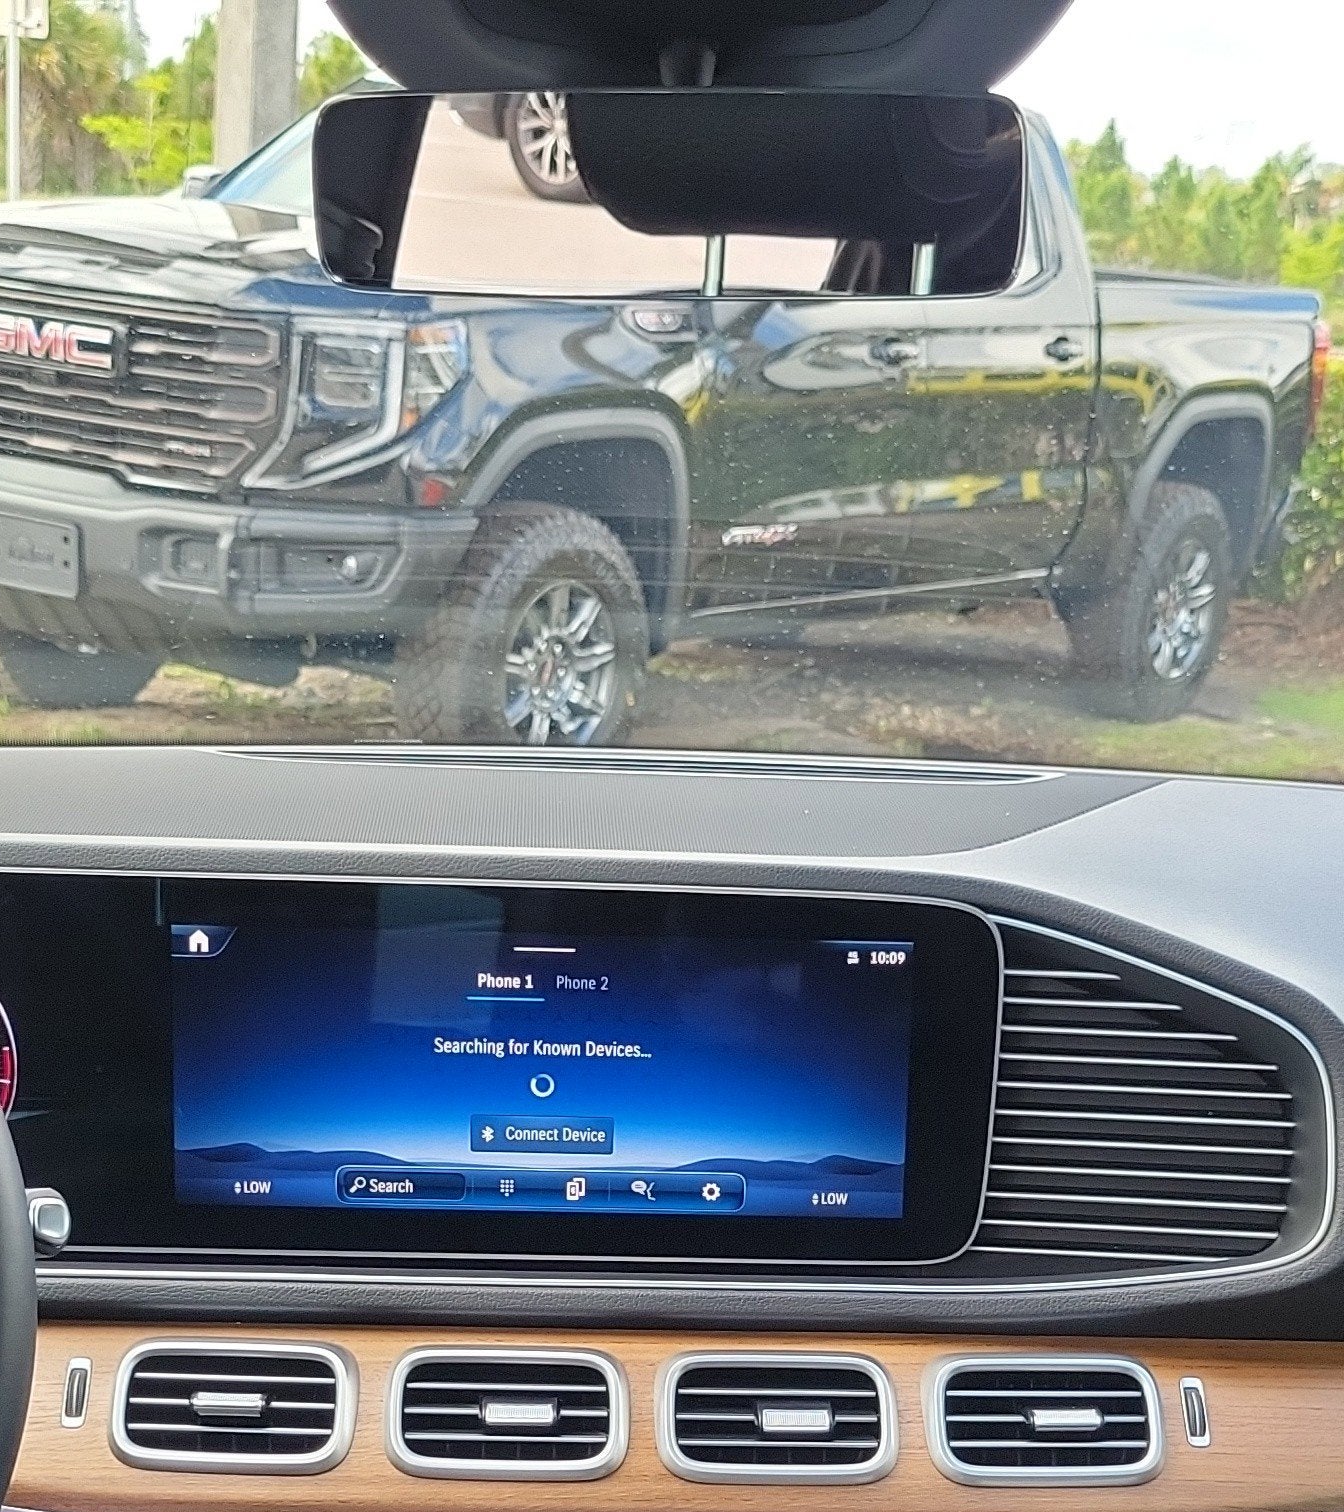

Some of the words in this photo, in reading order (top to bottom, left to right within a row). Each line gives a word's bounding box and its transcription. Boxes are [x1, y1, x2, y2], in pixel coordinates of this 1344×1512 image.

[870, 951, 906, 965] 10:09
[477, 973, 521, 989] Phone
[524, 974, 534, 989] 1
[556, 975, 597, 990] Phone
[600, 976, 609, 991] 2
[434, 1037, 505, 1058] Searching
[508, 1038, 530, 1055] for
[533, 1039, 581, 1057] Known
[585, 1041, 653, 1059] Devices...
[505, 1126, 559, 1142] Connect
[563, 1128, 606, 1142] Device
[243, 1181, 272, 1194] LOW
[369, 1179, 414, 1195] Search
[821, 1193, 849, 1205] LOW
